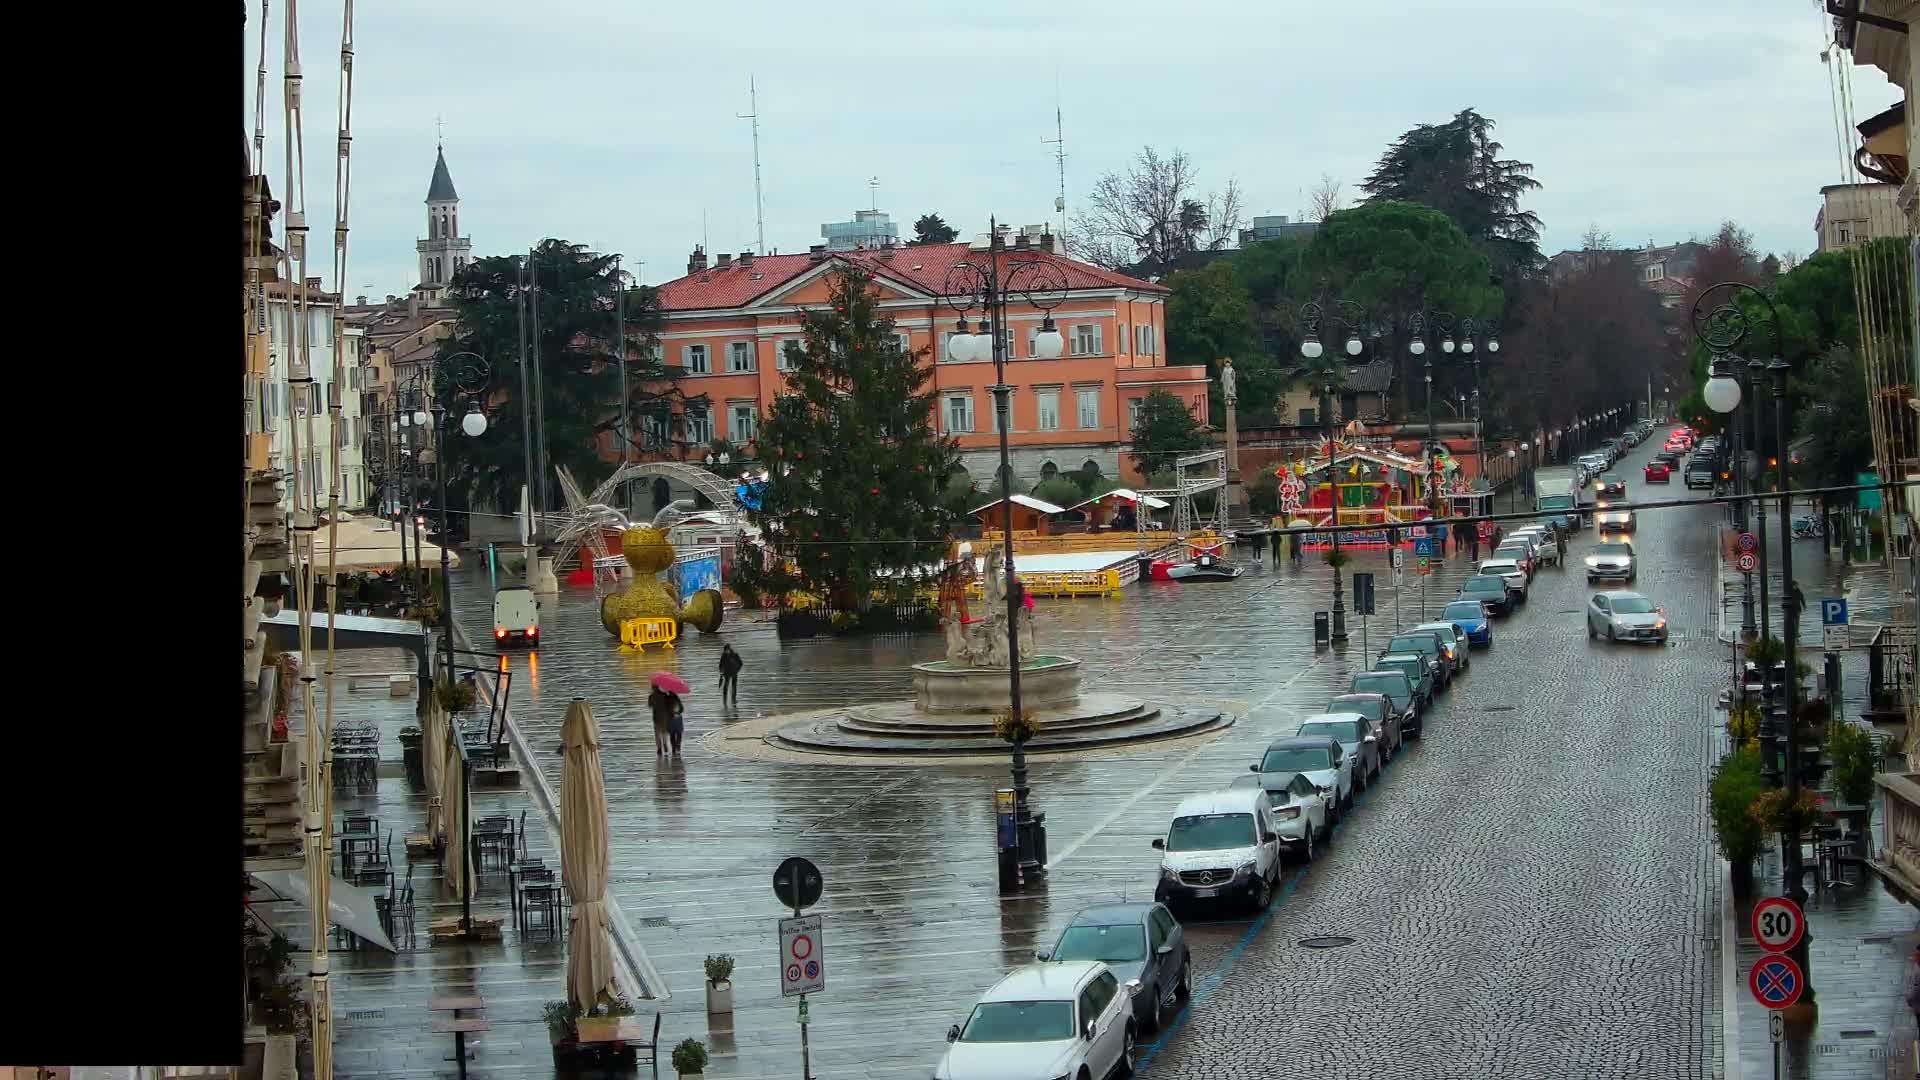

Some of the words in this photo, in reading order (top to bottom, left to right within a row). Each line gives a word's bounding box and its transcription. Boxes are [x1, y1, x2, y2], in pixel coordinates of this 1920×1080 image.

[1742, 557, 1752, 567] 20
[1827, 602, 1841, 621] P
[1762, 912, 1791, 937] 30
